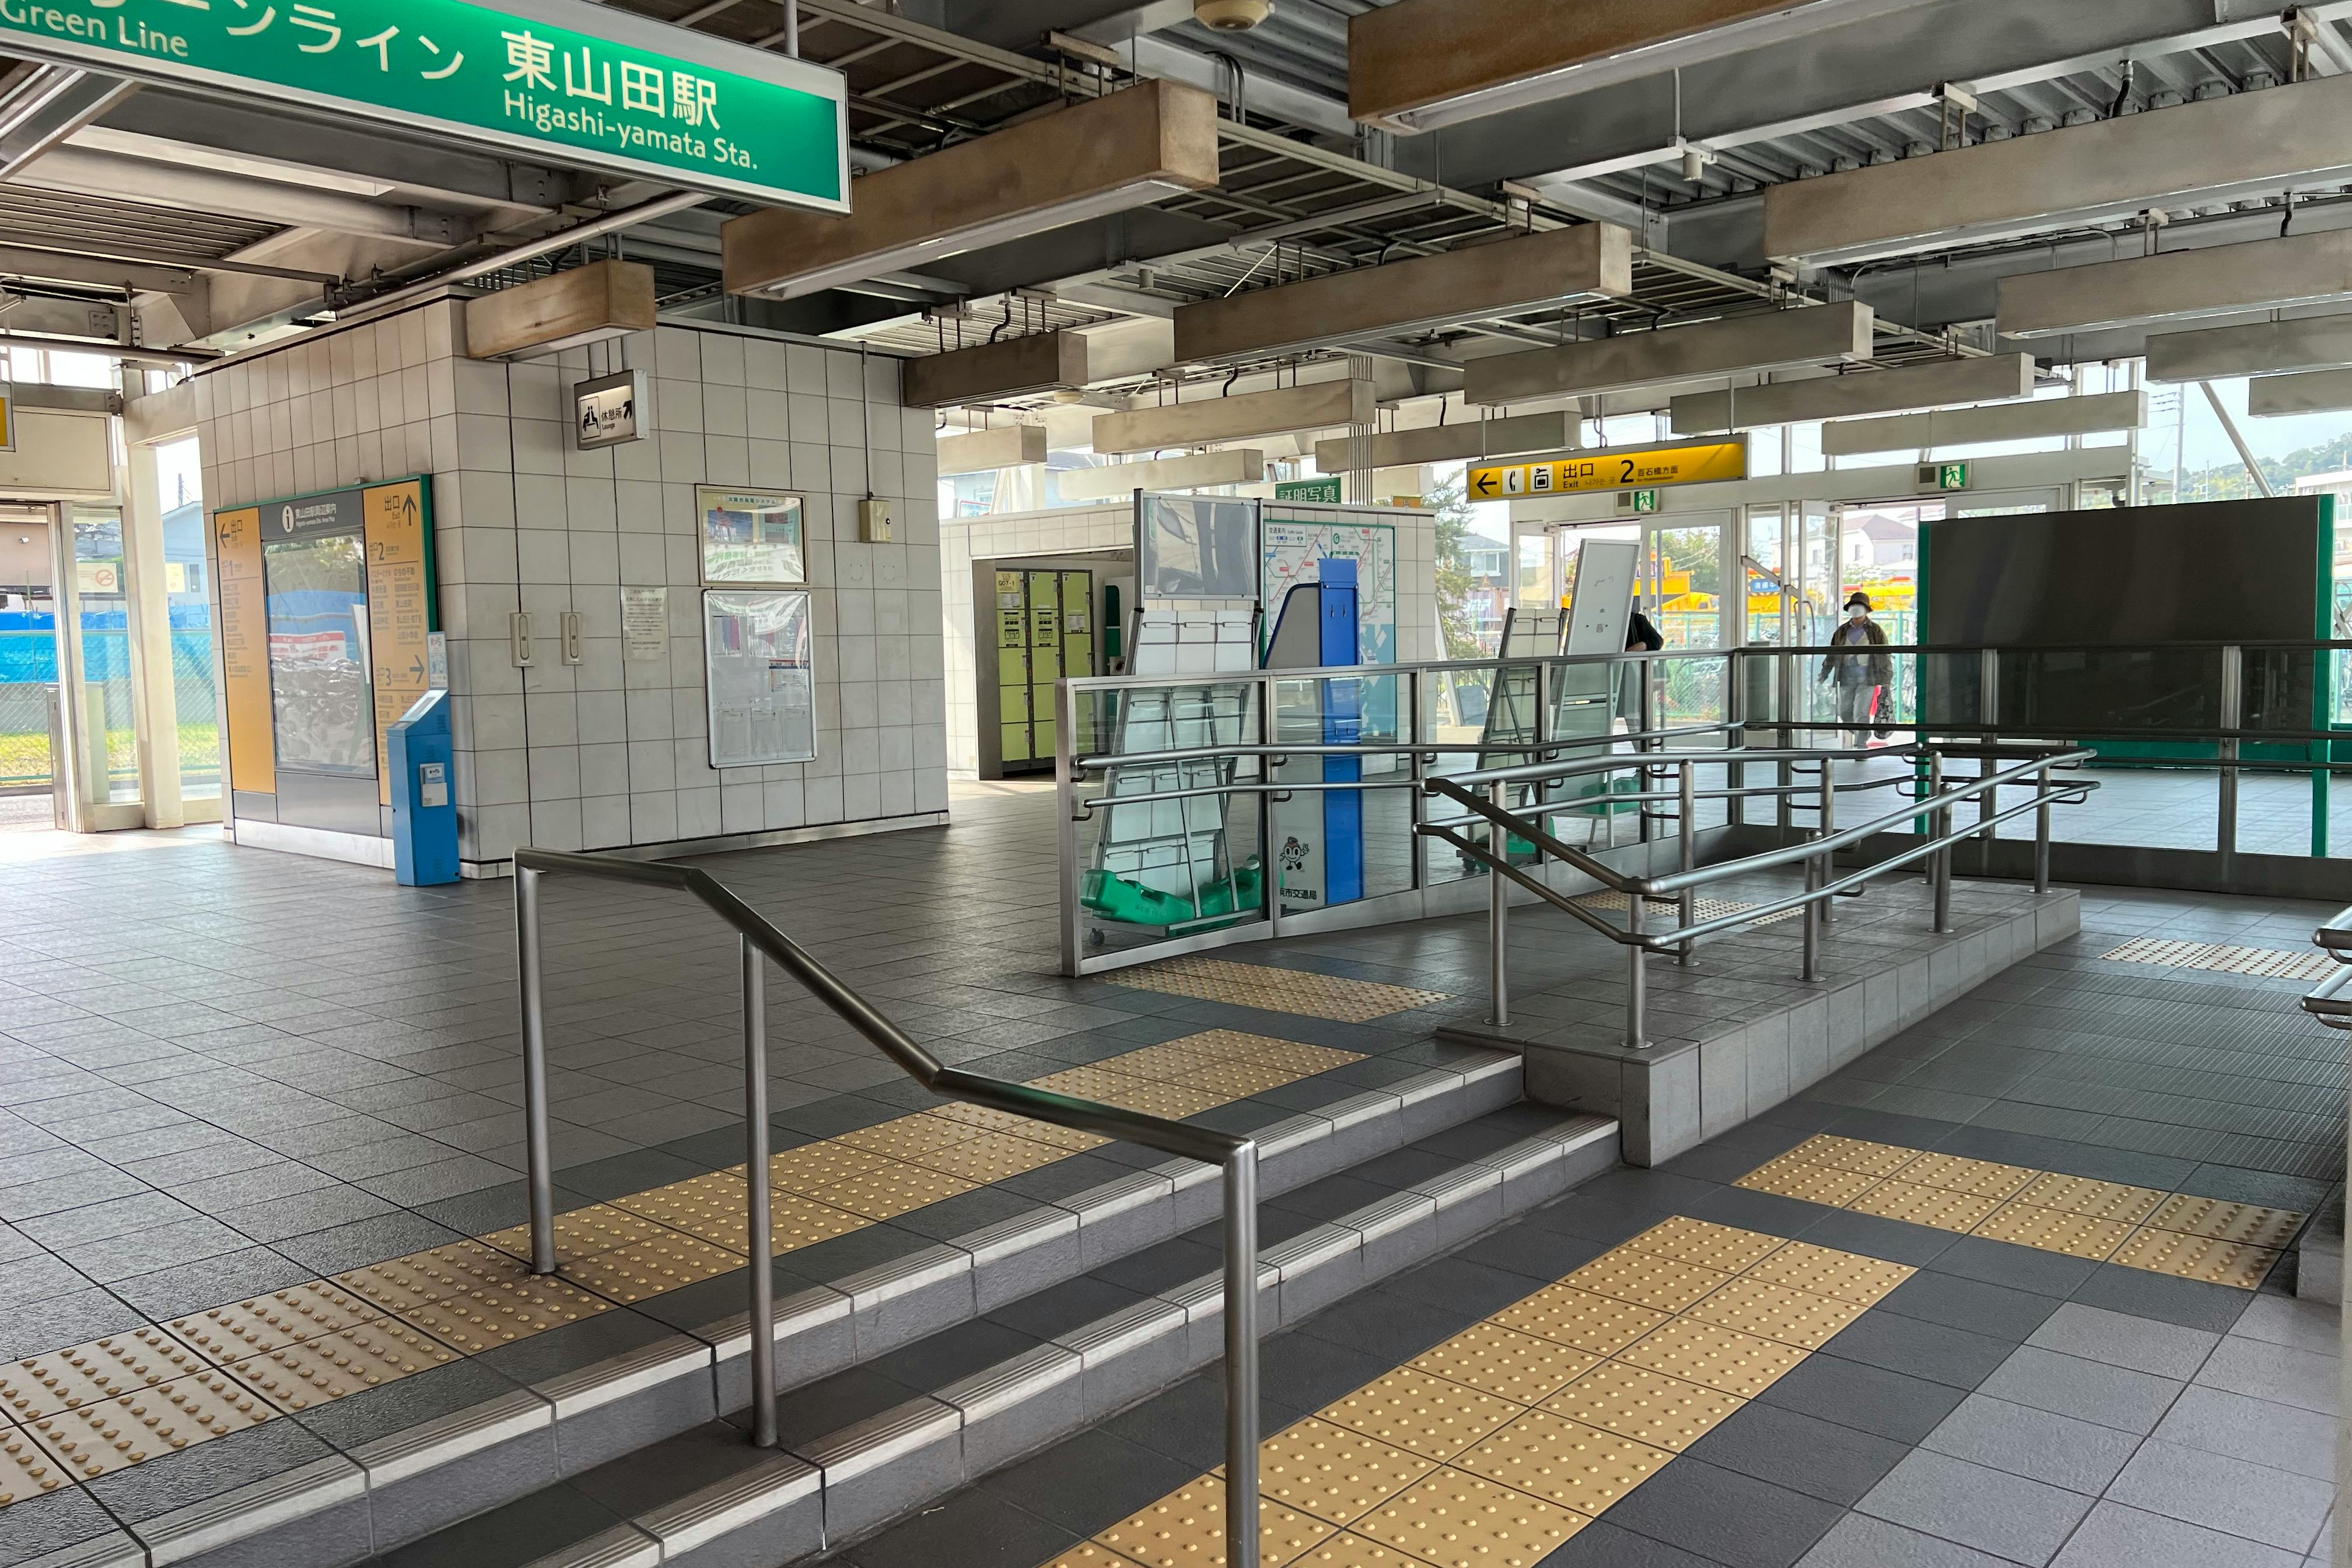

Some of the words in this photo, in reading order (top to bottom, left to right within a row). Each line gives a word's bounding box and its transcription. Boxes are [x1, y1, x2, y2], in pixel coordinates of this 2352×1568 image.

[0, 0, 106, 40] Green
[118, 16, 188, 57] Line
[501, 30, 721, 130] 東山田駅
[504, 89, 706, 159] Higashi-yamata
[713, 137, 758, 170] Sta.
[601, 407, 622, 421] 休憩所
[1563, 463, 1594, 479] 出口
[1620, 460, 1634, 484] 2
[1637, 466, 1678, 477] 百石橋方面
[384, 495, 400, 511] 出口
[1279, 485, 1337, 502] 証明写真
[230, 520, 243, 533] 出口
[378, 542, 384, 561] 2
[385, 667, 391, 686] 3
